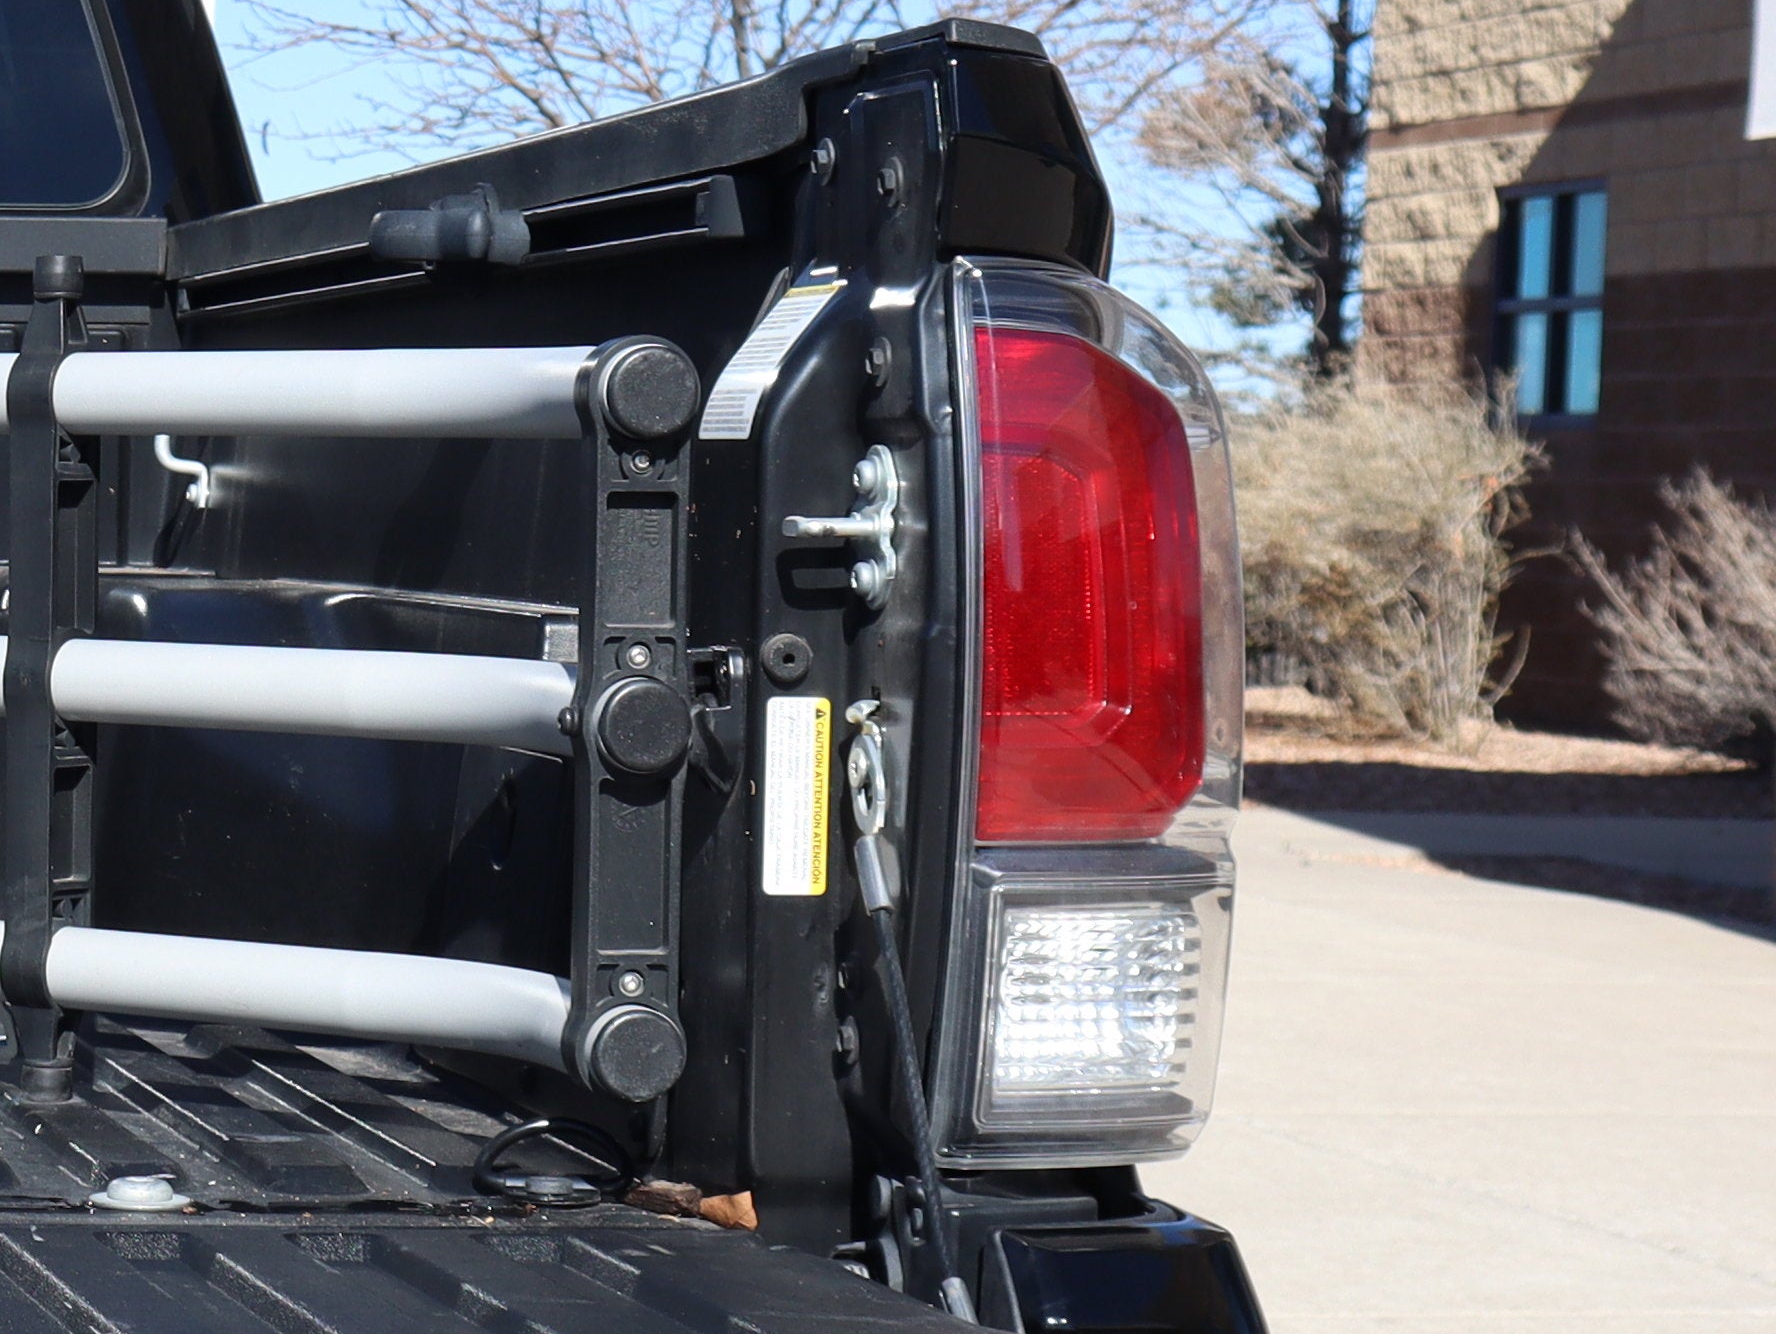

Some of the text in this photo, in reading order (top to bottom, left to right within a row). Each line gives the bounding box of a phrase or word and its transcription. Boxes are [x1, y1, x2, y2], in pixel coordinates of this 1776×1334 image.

[812, 722, 825, 885] CAUTION ATTENTION ATENCIÓN
